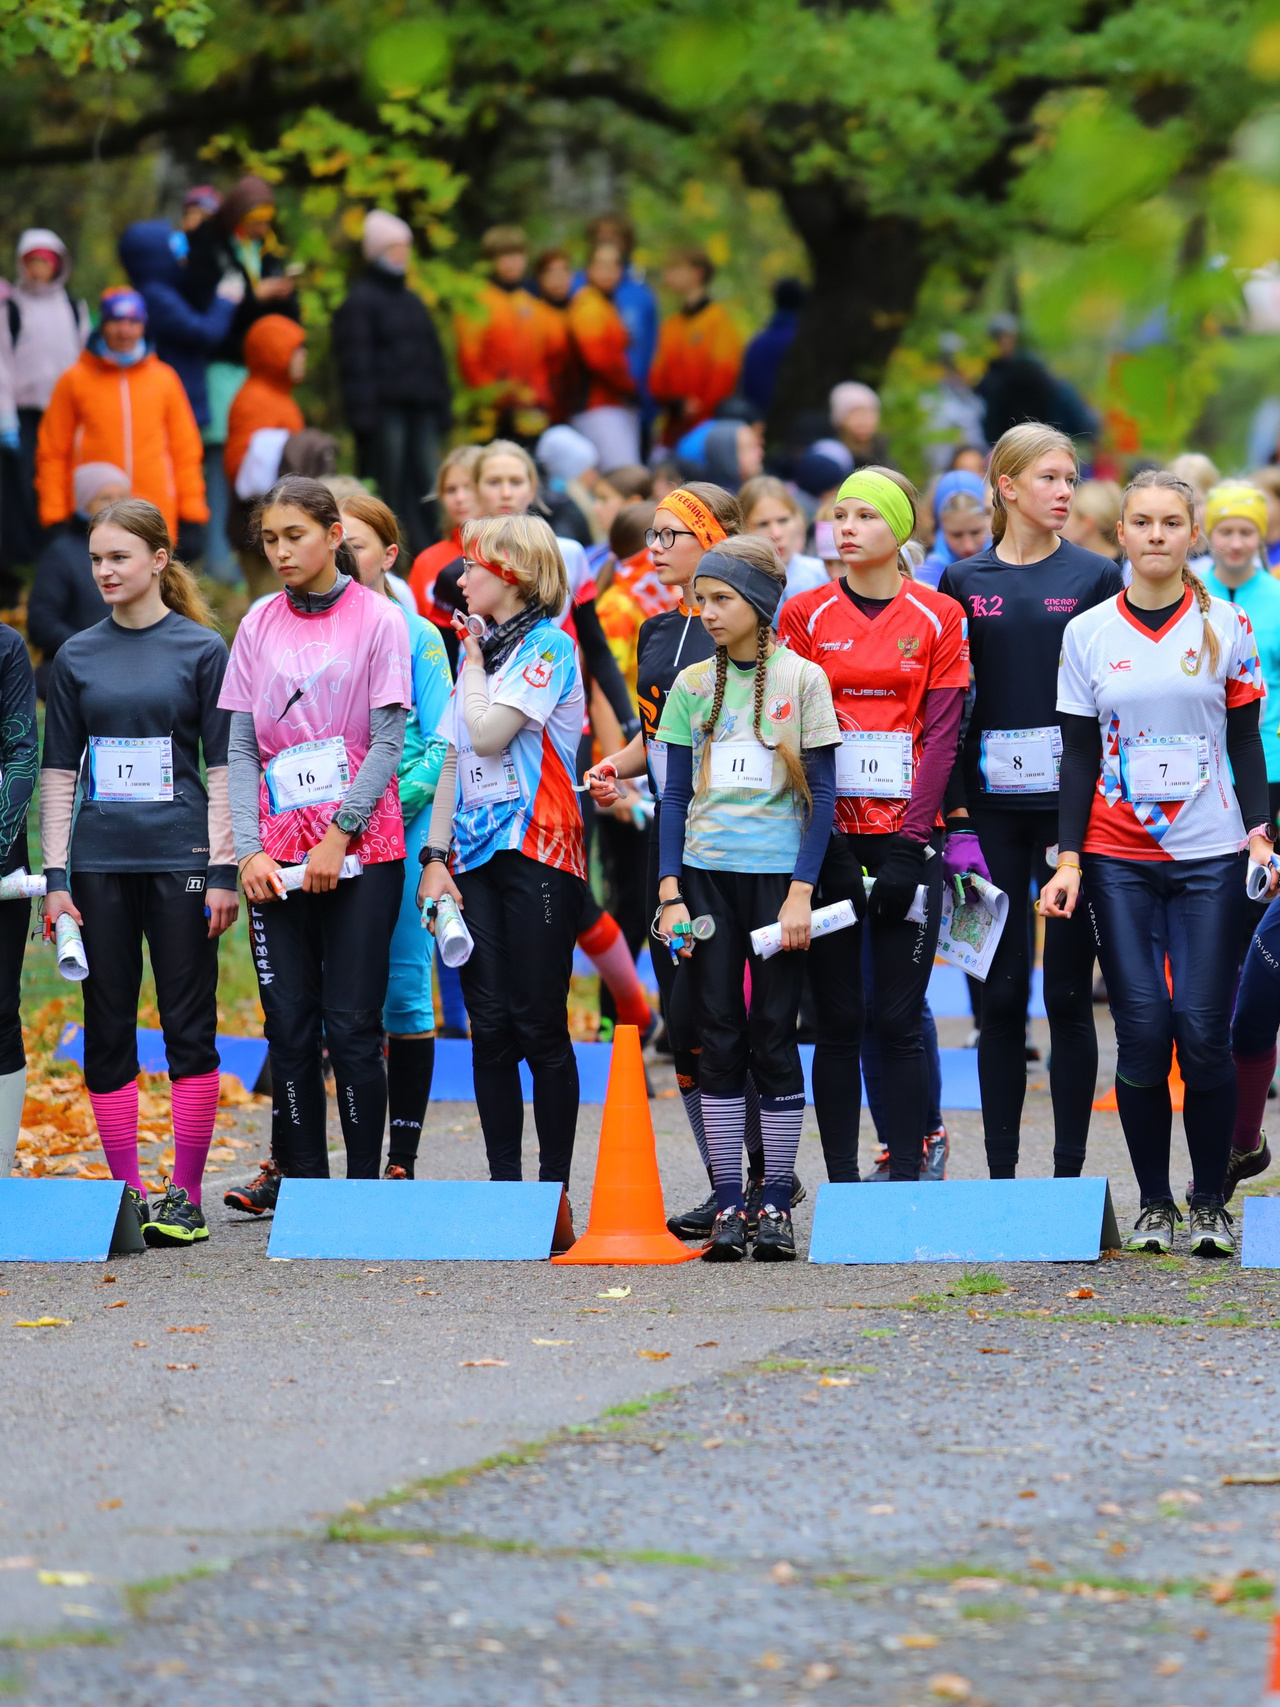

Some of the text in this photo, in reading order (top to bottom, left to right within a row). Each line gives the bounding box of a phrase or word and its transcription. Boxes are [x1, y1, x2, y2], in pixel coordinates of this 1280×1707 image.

[968, 594, 1004, 618] K2
[1043, 598, 1079, 607] ENERGY
[842, 688, 897, 696] RUSSIA
[731, 758, 745, 772] 11
[860, 758, 879, 774] 10
[1013, 755, 1023, 770] 8
[117, 764, 134, 779] 17
[297, 769, 315, 787] 16
[470, 766, 483, 784] 15
[1159, 763, 1168, 778] 7
[251, 905, 275, 986] НАВСЕГ
